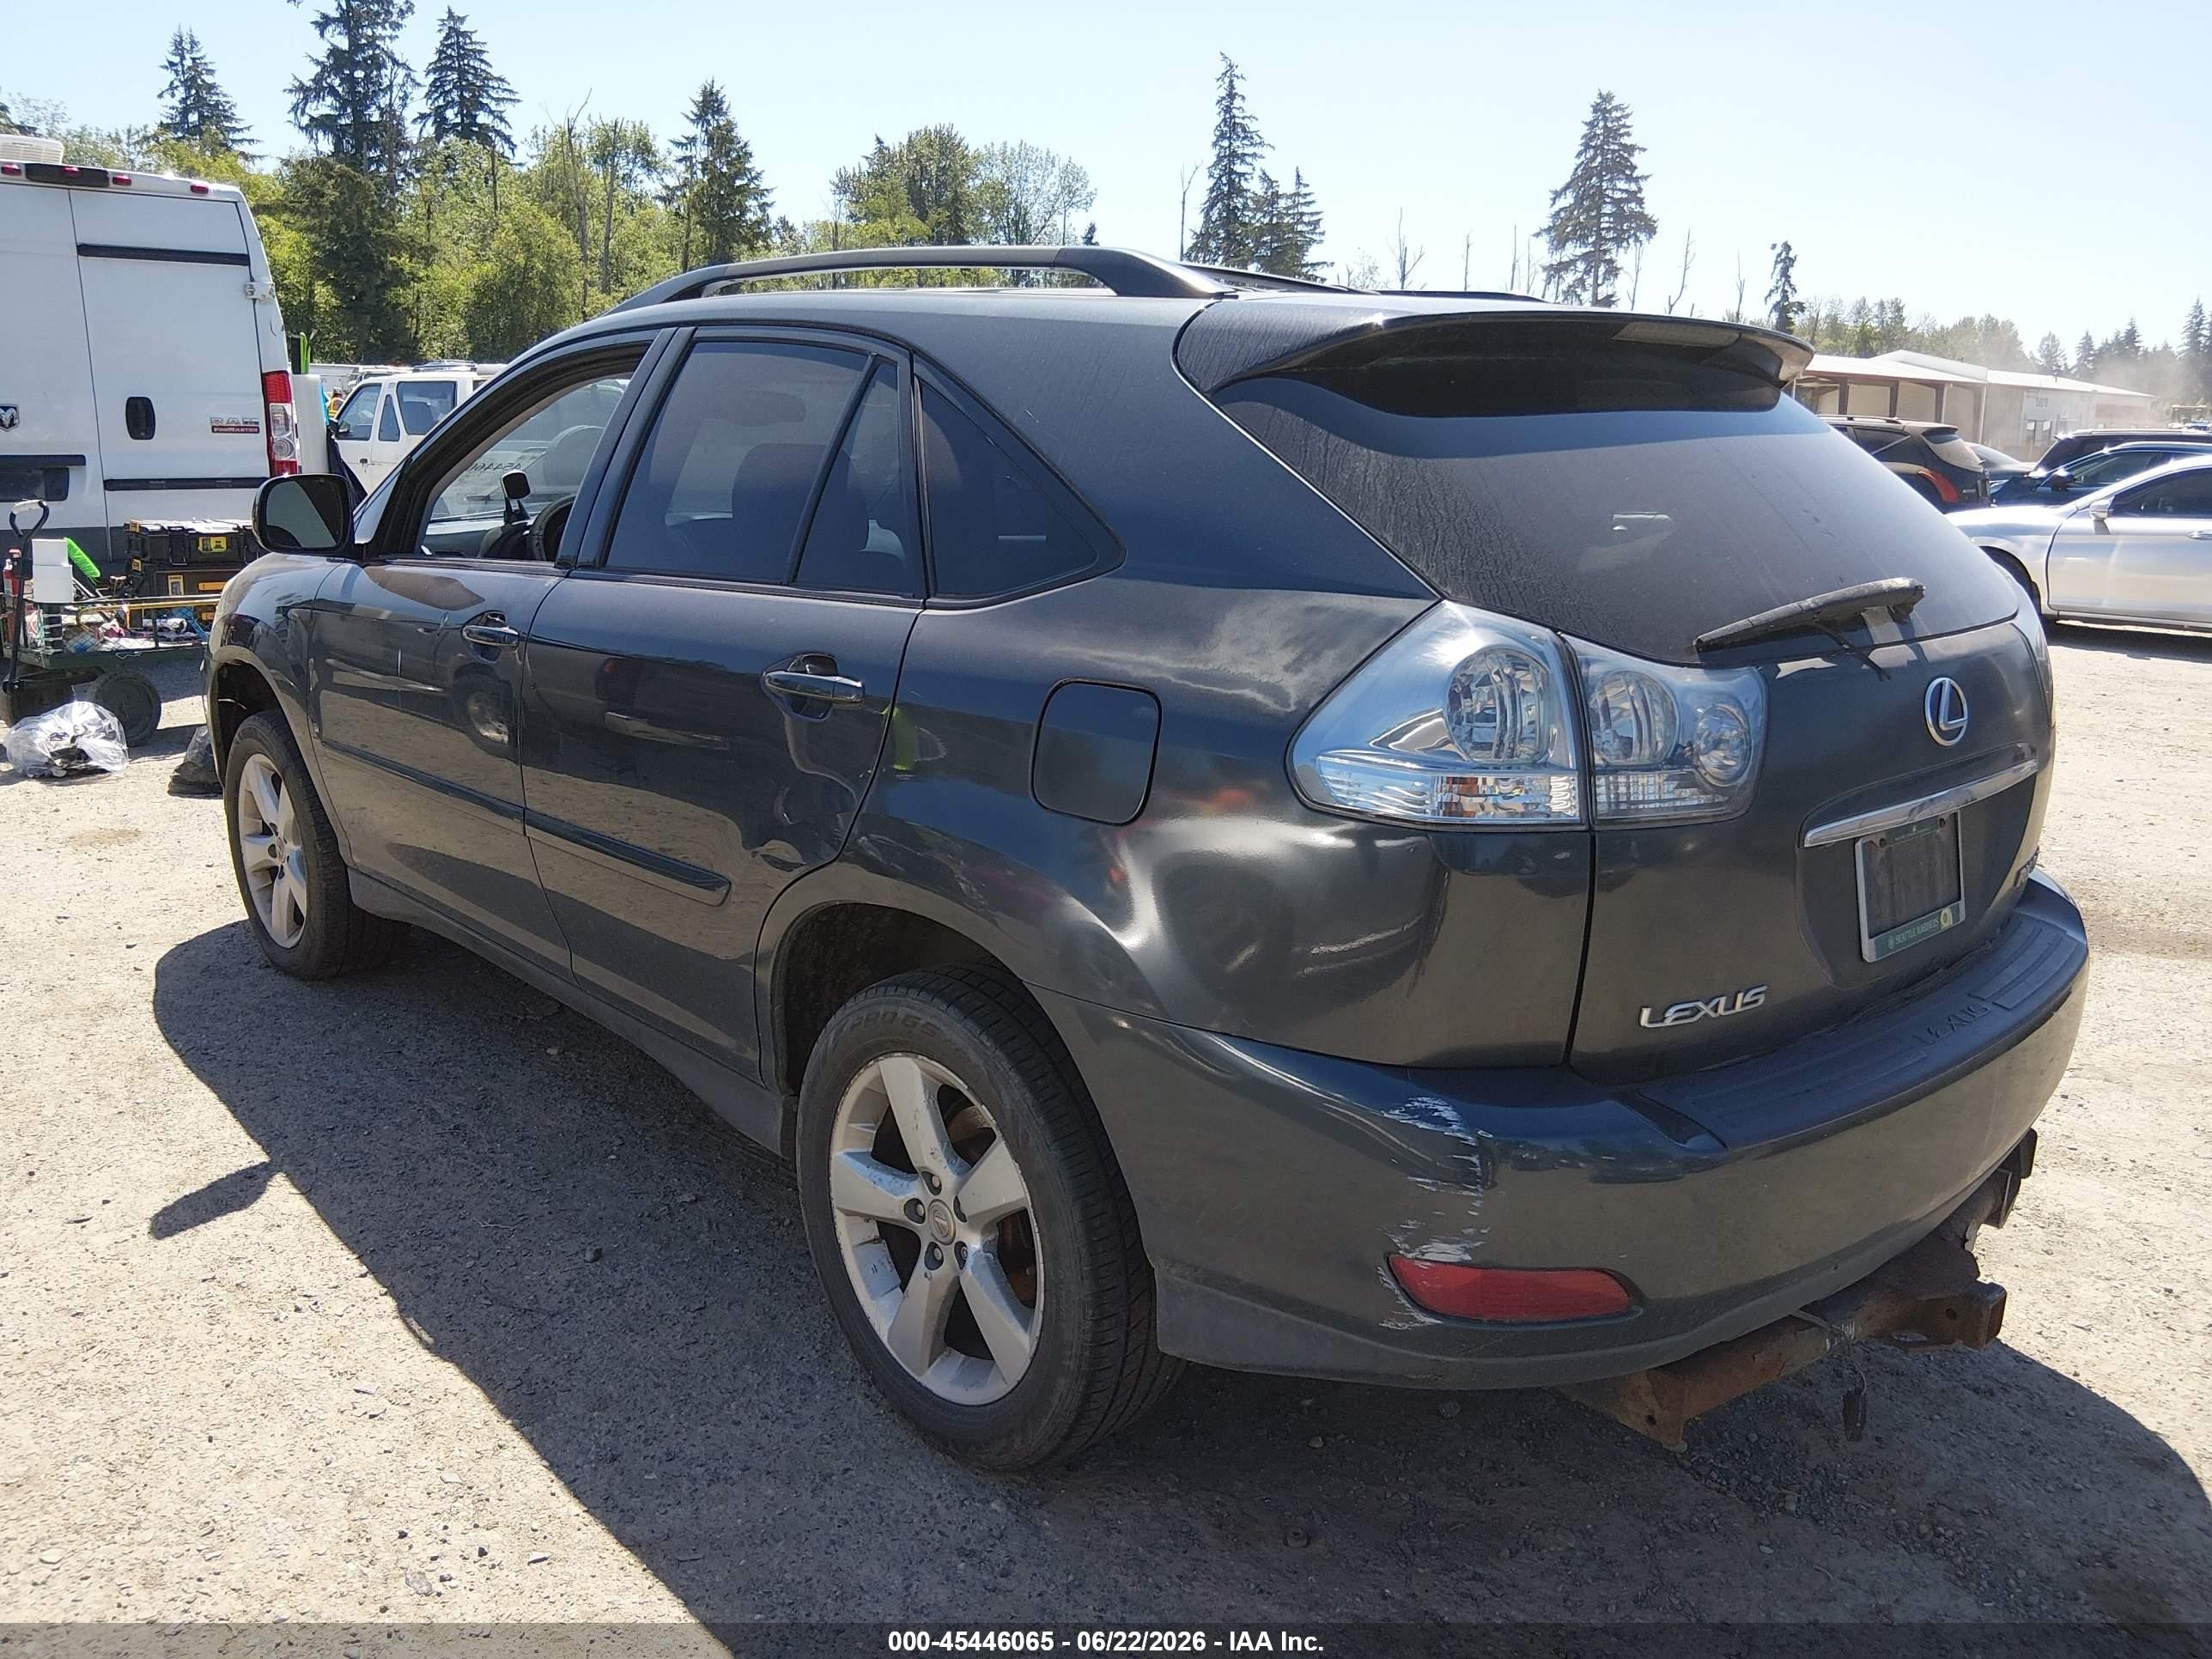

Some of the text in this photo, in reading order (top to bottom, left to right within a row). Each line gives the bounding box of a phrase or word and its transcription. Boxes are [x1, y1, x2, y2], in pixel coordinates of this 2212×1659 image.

[210, 417, 259, 426] RAM
[1895, 926, 1917, 944] SEATTLE
[1639, 985, 1767, 1029] LEXUS
[1911, 1005, 1990, 1045] LEXUS
